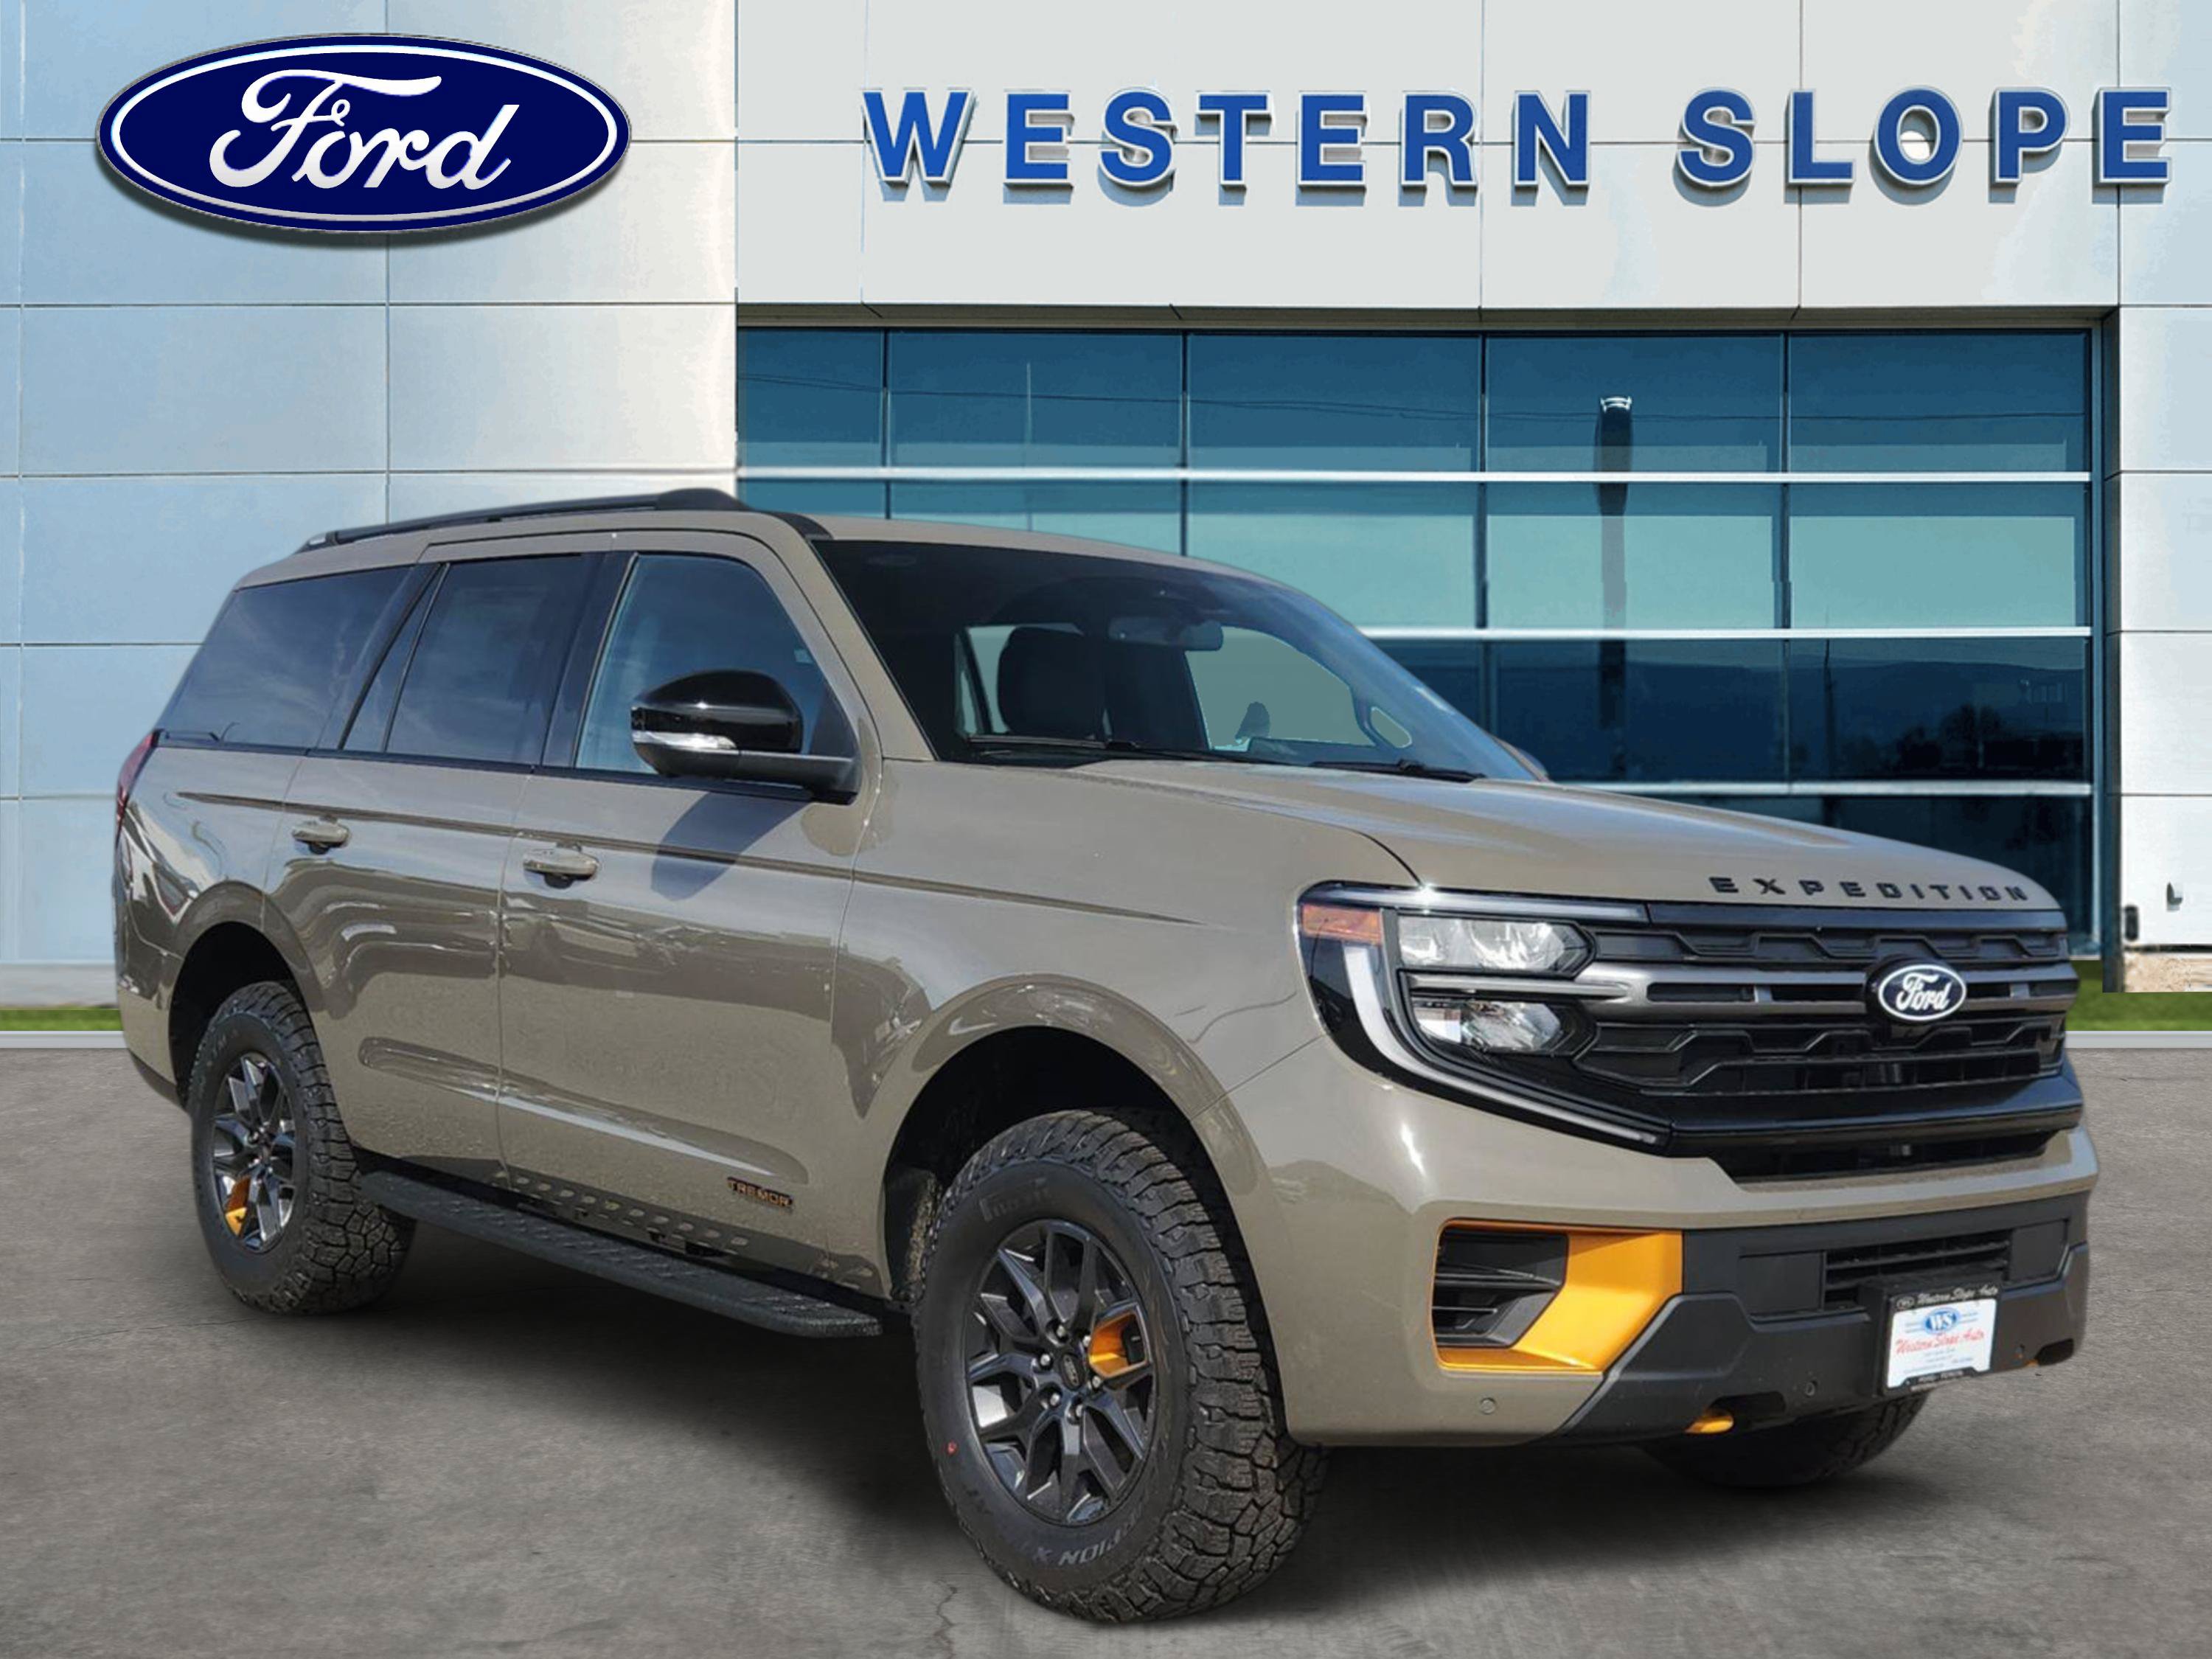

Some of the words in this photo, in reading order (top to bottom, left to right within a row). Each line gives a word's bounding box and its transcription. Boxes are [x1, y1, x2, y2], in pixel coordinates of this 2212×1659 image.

[209, 69, 520, 189] Ford
[860, 87, 1592, 190] WESTERN
[1675, 86, 2172, 189] SLOPE
[1708, 876, 2029, 902] EXPEDITION
[1895, 972, 1953, 1011] Ford
[727, 1177, 794, 1208] TREMOR
[1929, 1312, 1955, 1332] WS
